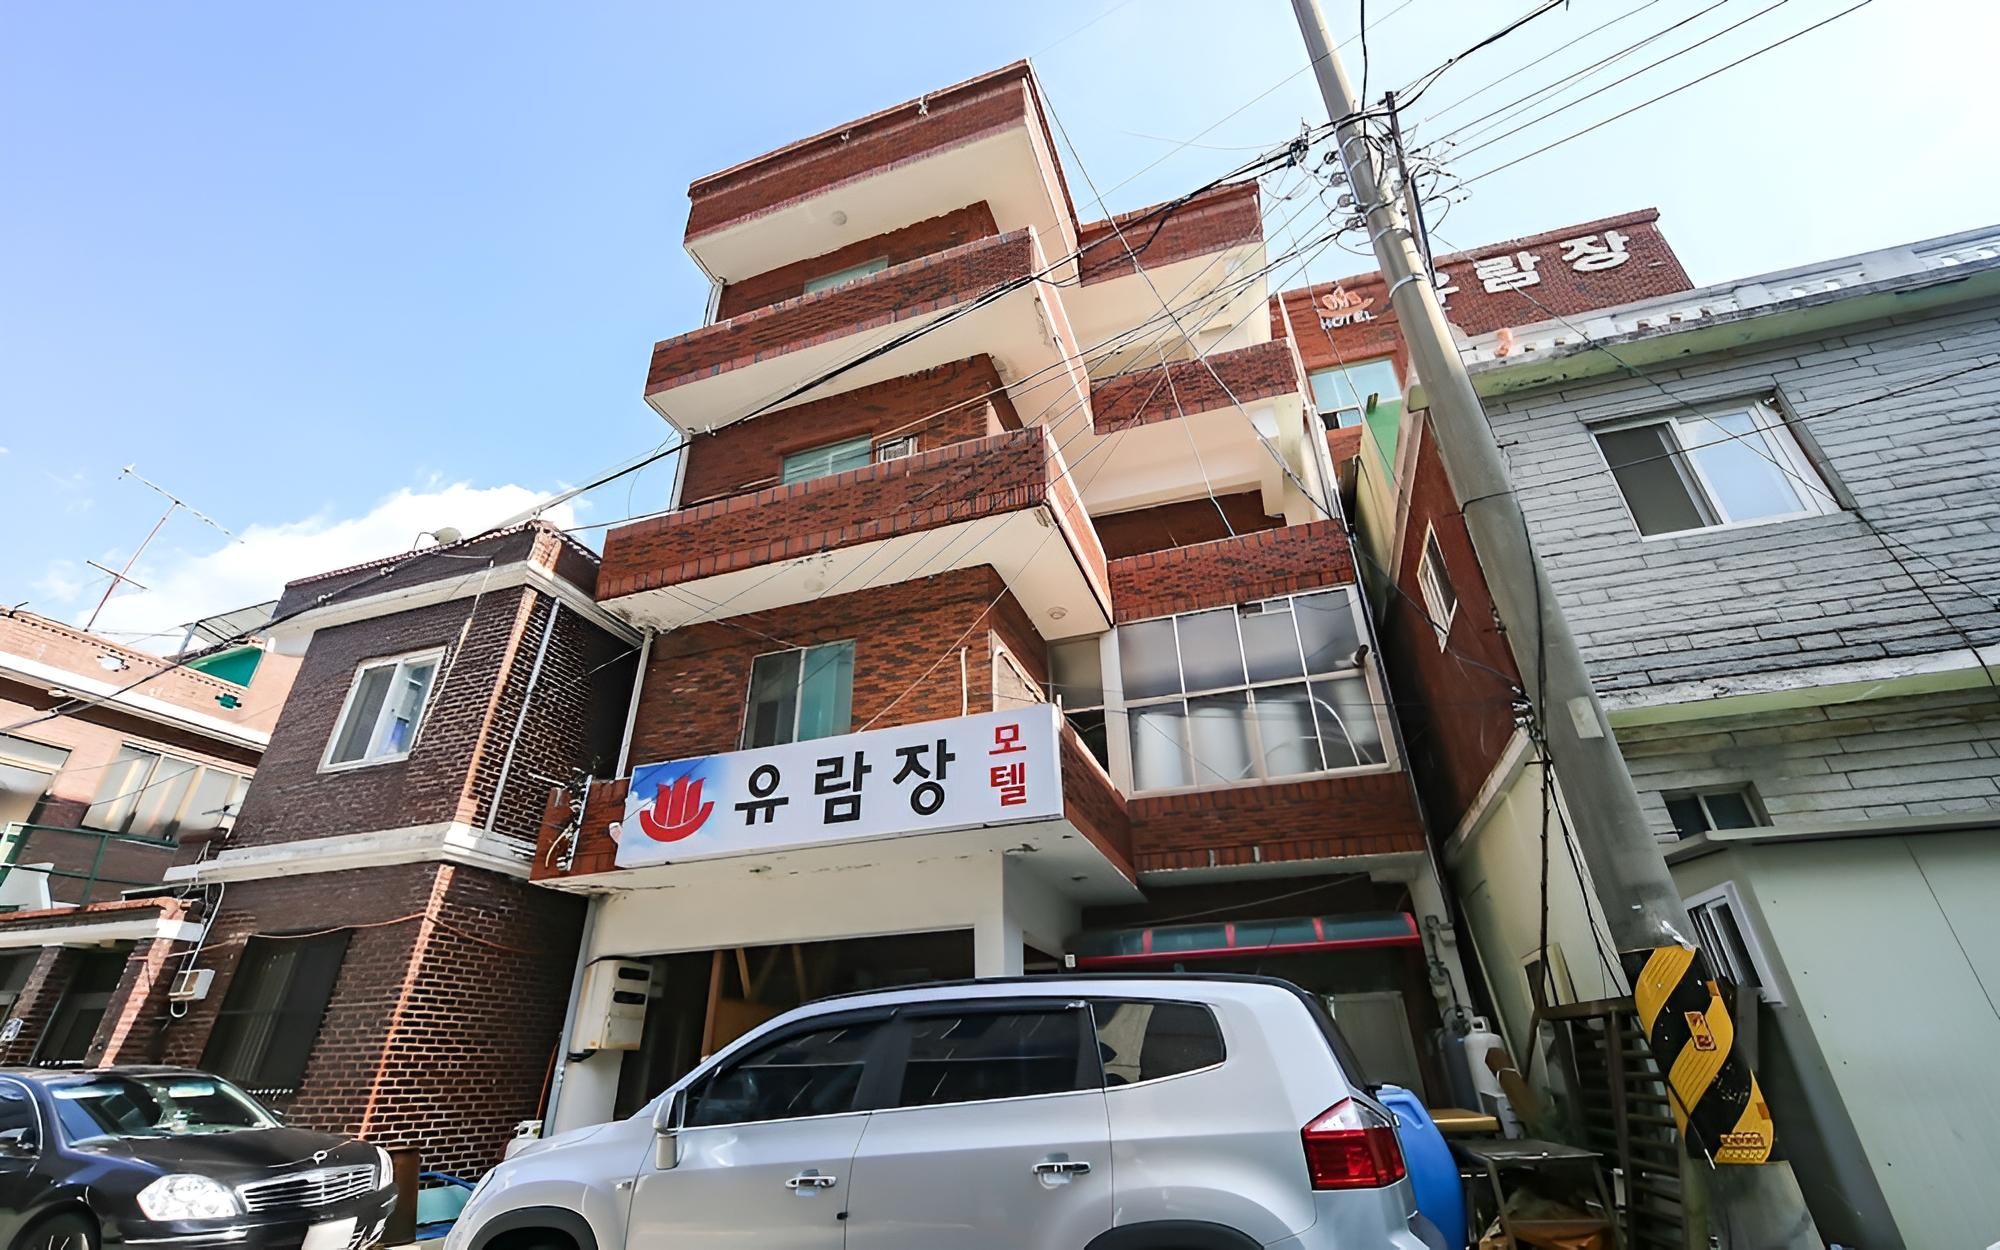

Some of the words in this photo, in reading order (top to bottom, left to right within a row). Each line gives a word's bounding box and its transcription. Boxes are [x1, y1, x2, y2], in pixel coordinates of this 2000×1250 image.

[1320, 310, 1378, 330] HOTEL
[734, 739, 956, 826] 유람장
[989, 723, 1027, 806] 모텔
